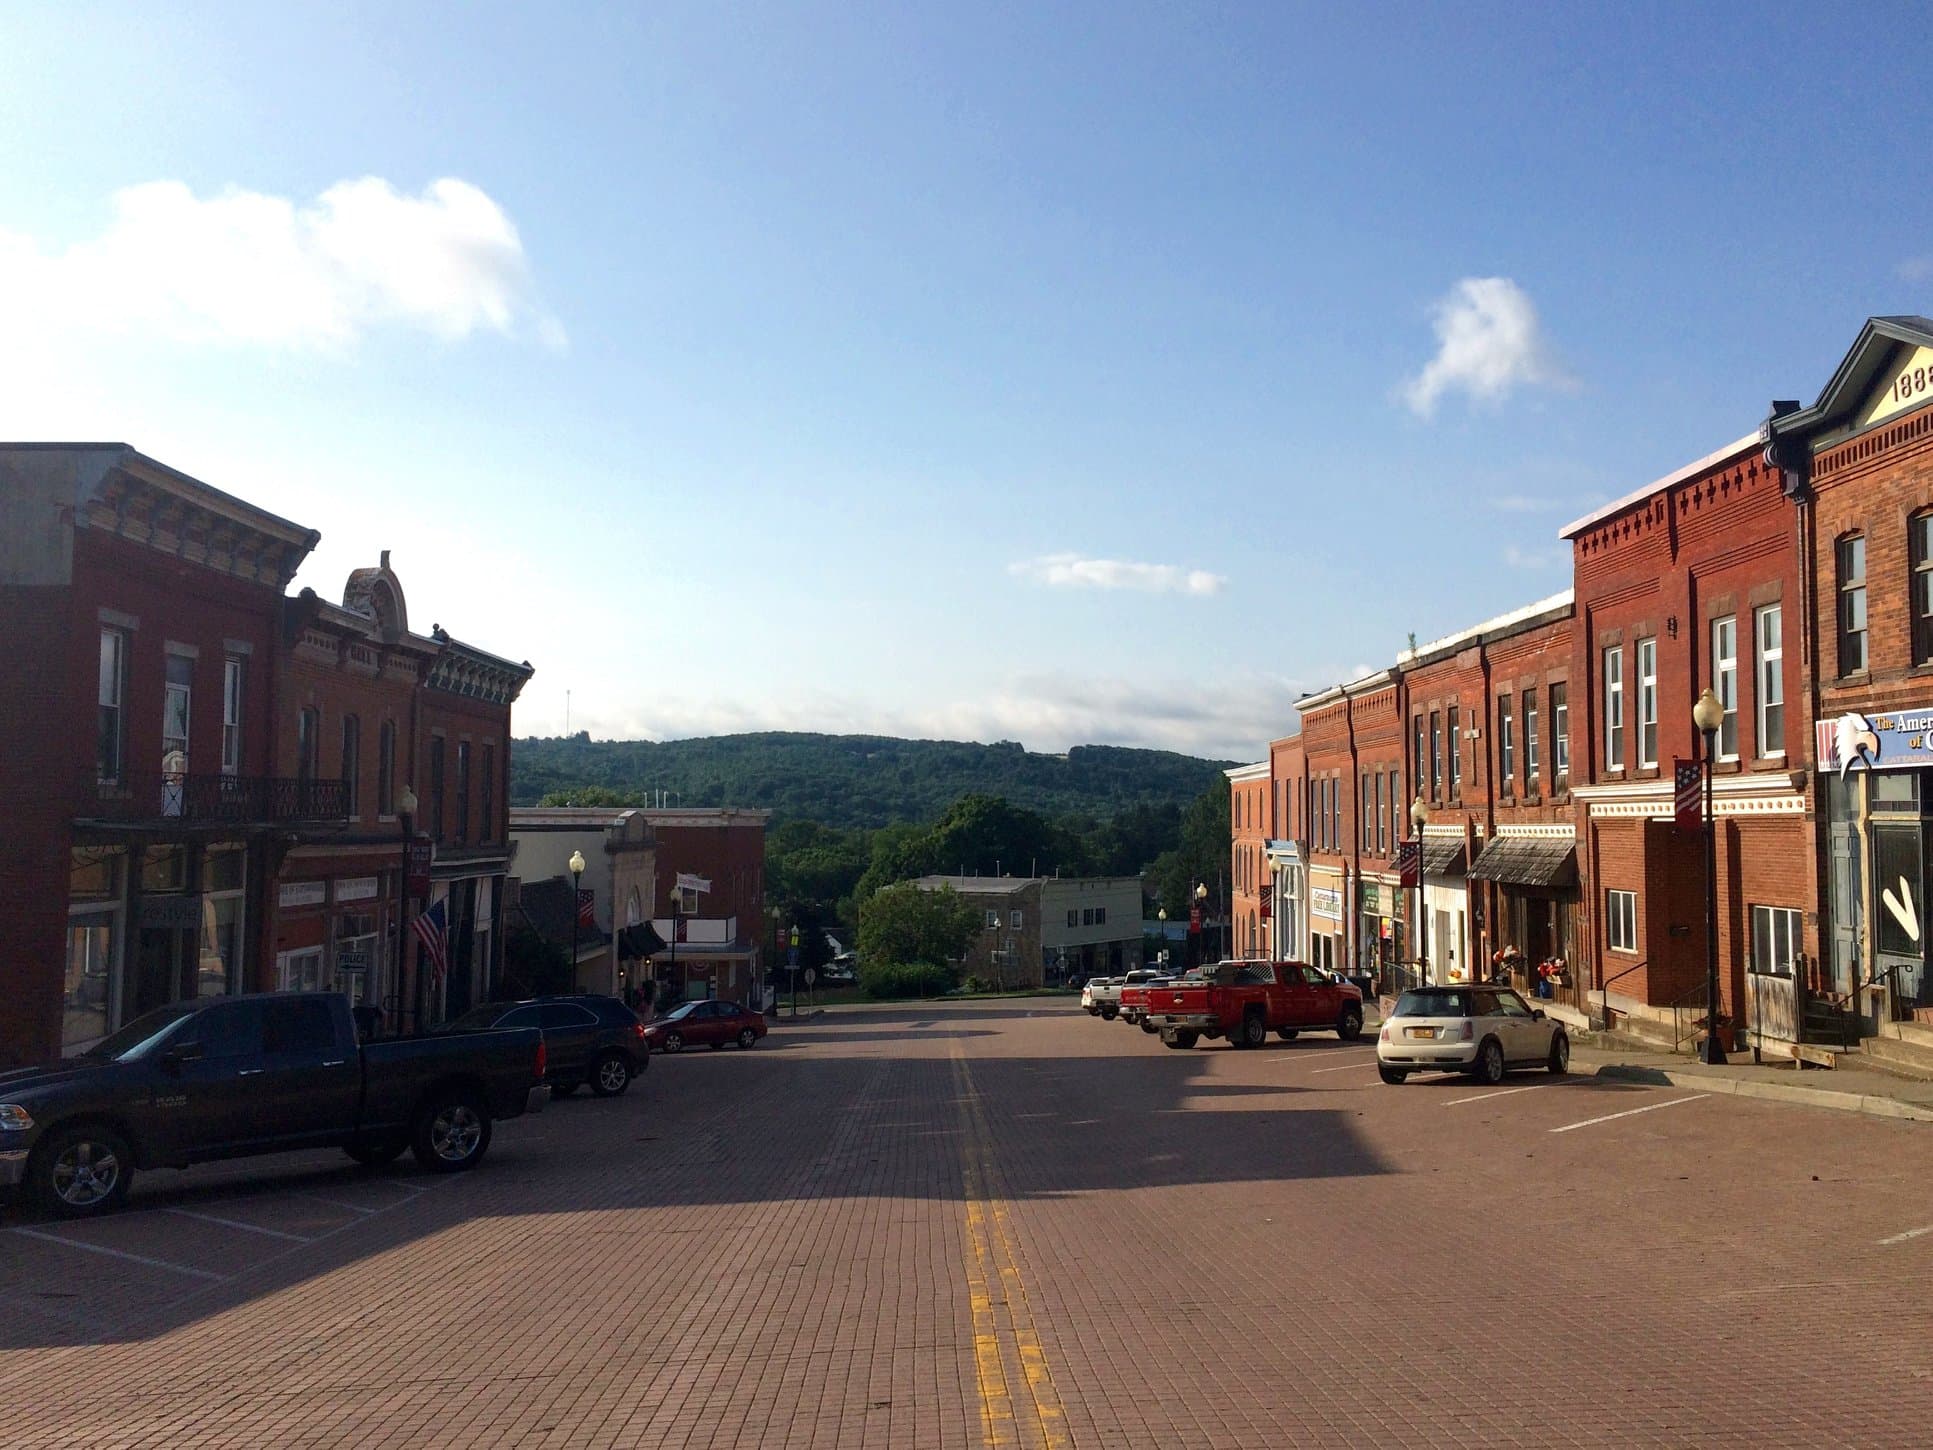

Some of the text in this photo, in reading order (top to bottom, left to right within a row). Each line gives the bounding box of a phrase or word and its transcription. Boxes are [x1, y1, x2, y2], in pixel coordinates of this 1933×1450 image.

[1875, 716, 1894, 730] The
[1909, 735, 1922, 749] of
[339, 953, 366, 963] POLICE
